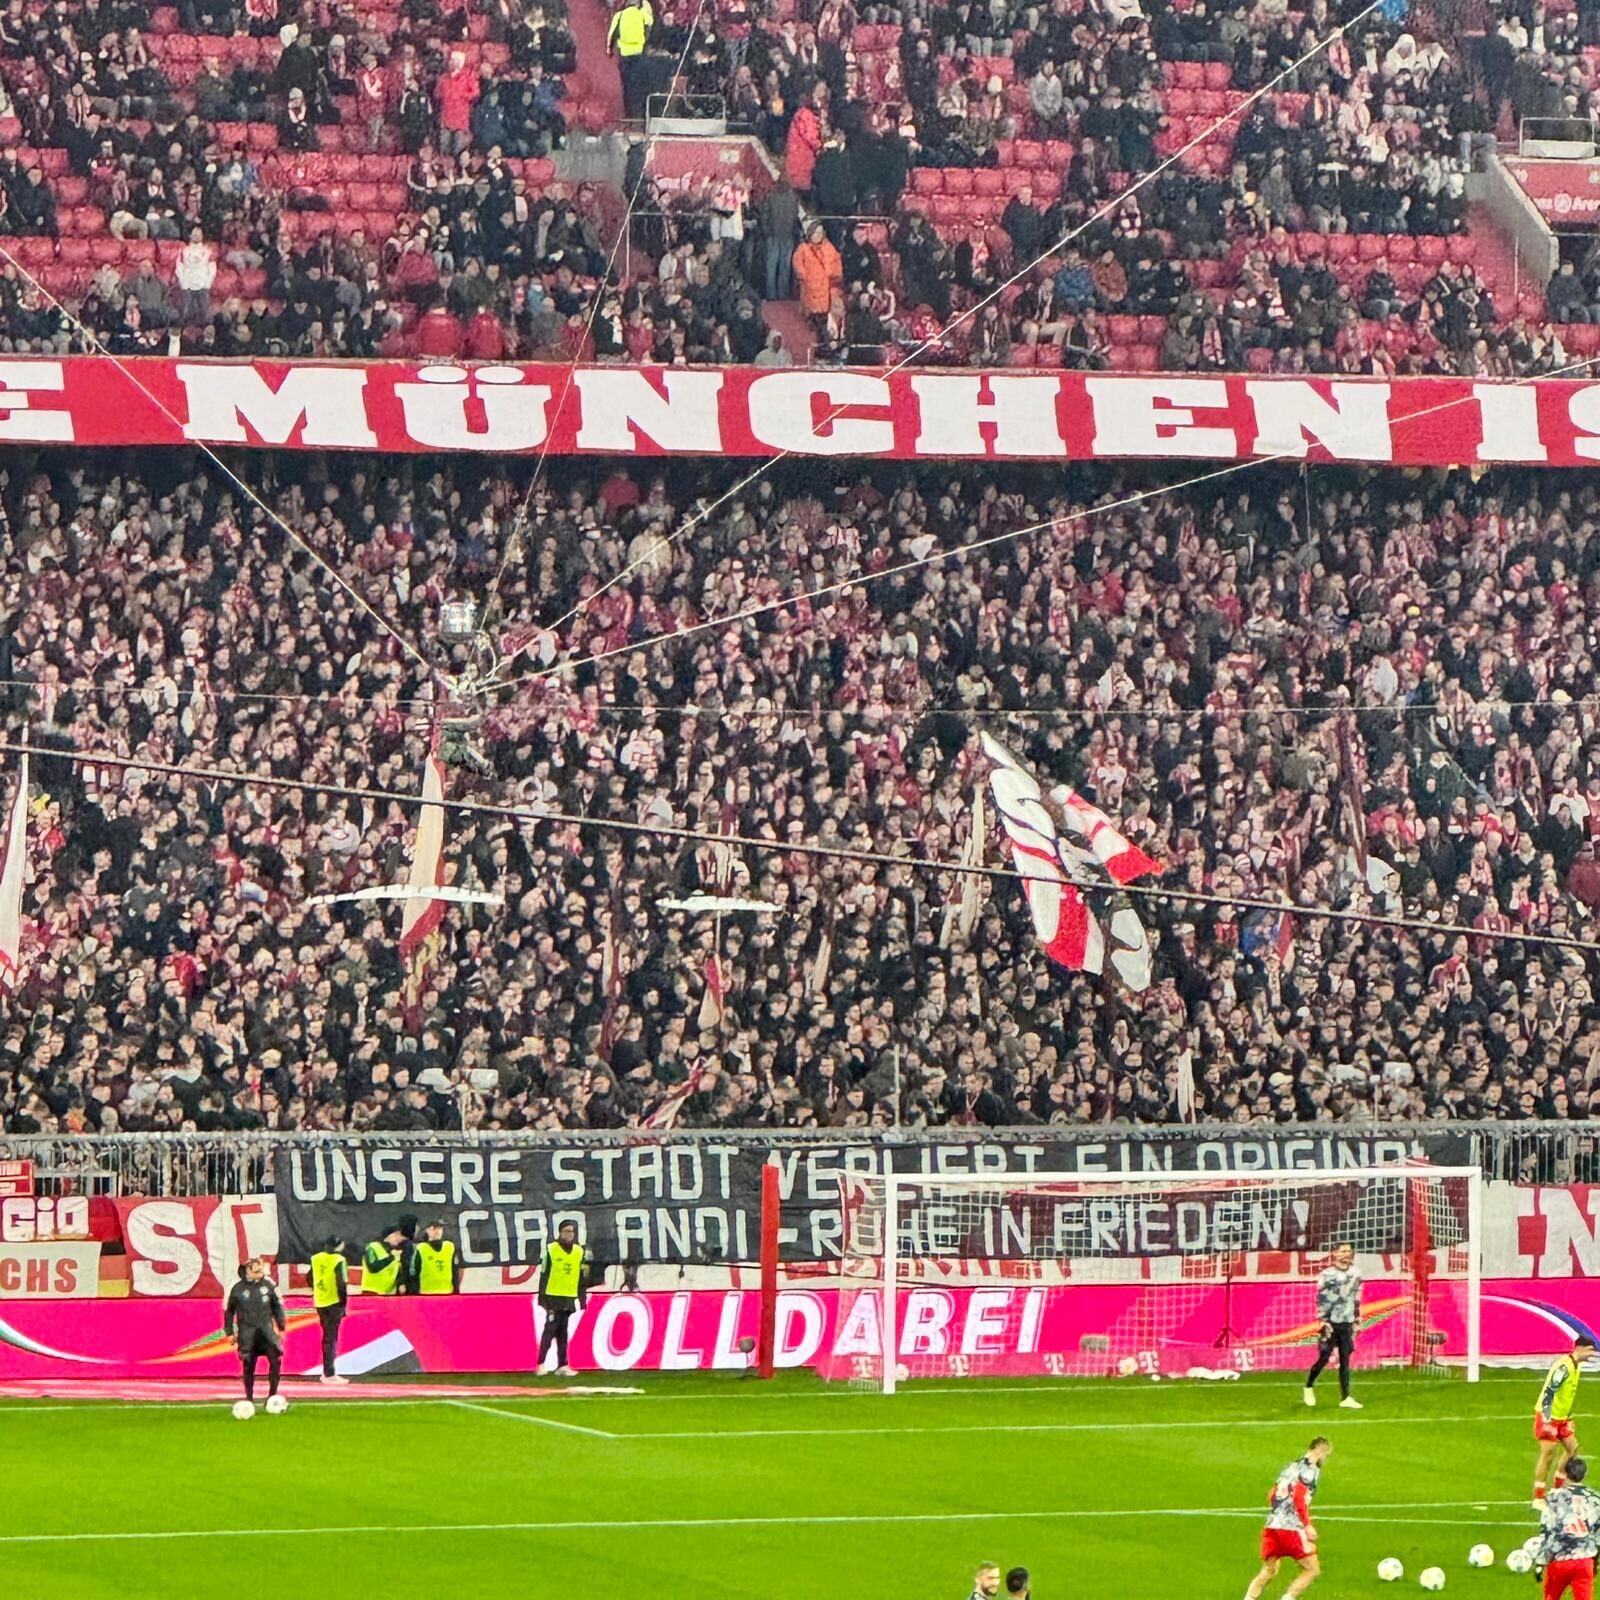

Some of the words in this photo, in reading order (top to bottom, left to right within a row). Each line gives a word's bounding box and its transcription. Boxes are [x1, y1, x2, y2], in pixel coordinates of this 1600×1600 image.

[176, 363, 1392, 461] MÜNCHEN
[290, 1149, 523, 1204] UNSERE
[552, 1145, 739, 1200] STADT
[458, 1209, 589, 1263] CIAO
[615, 1207, 749, 1260] ANDI
[809, 1209, 960, 1257] RUHE
[984, 1205, 1032, 1256] IN
[1053, 1201, 1309, 1252] FRIEDEN!
